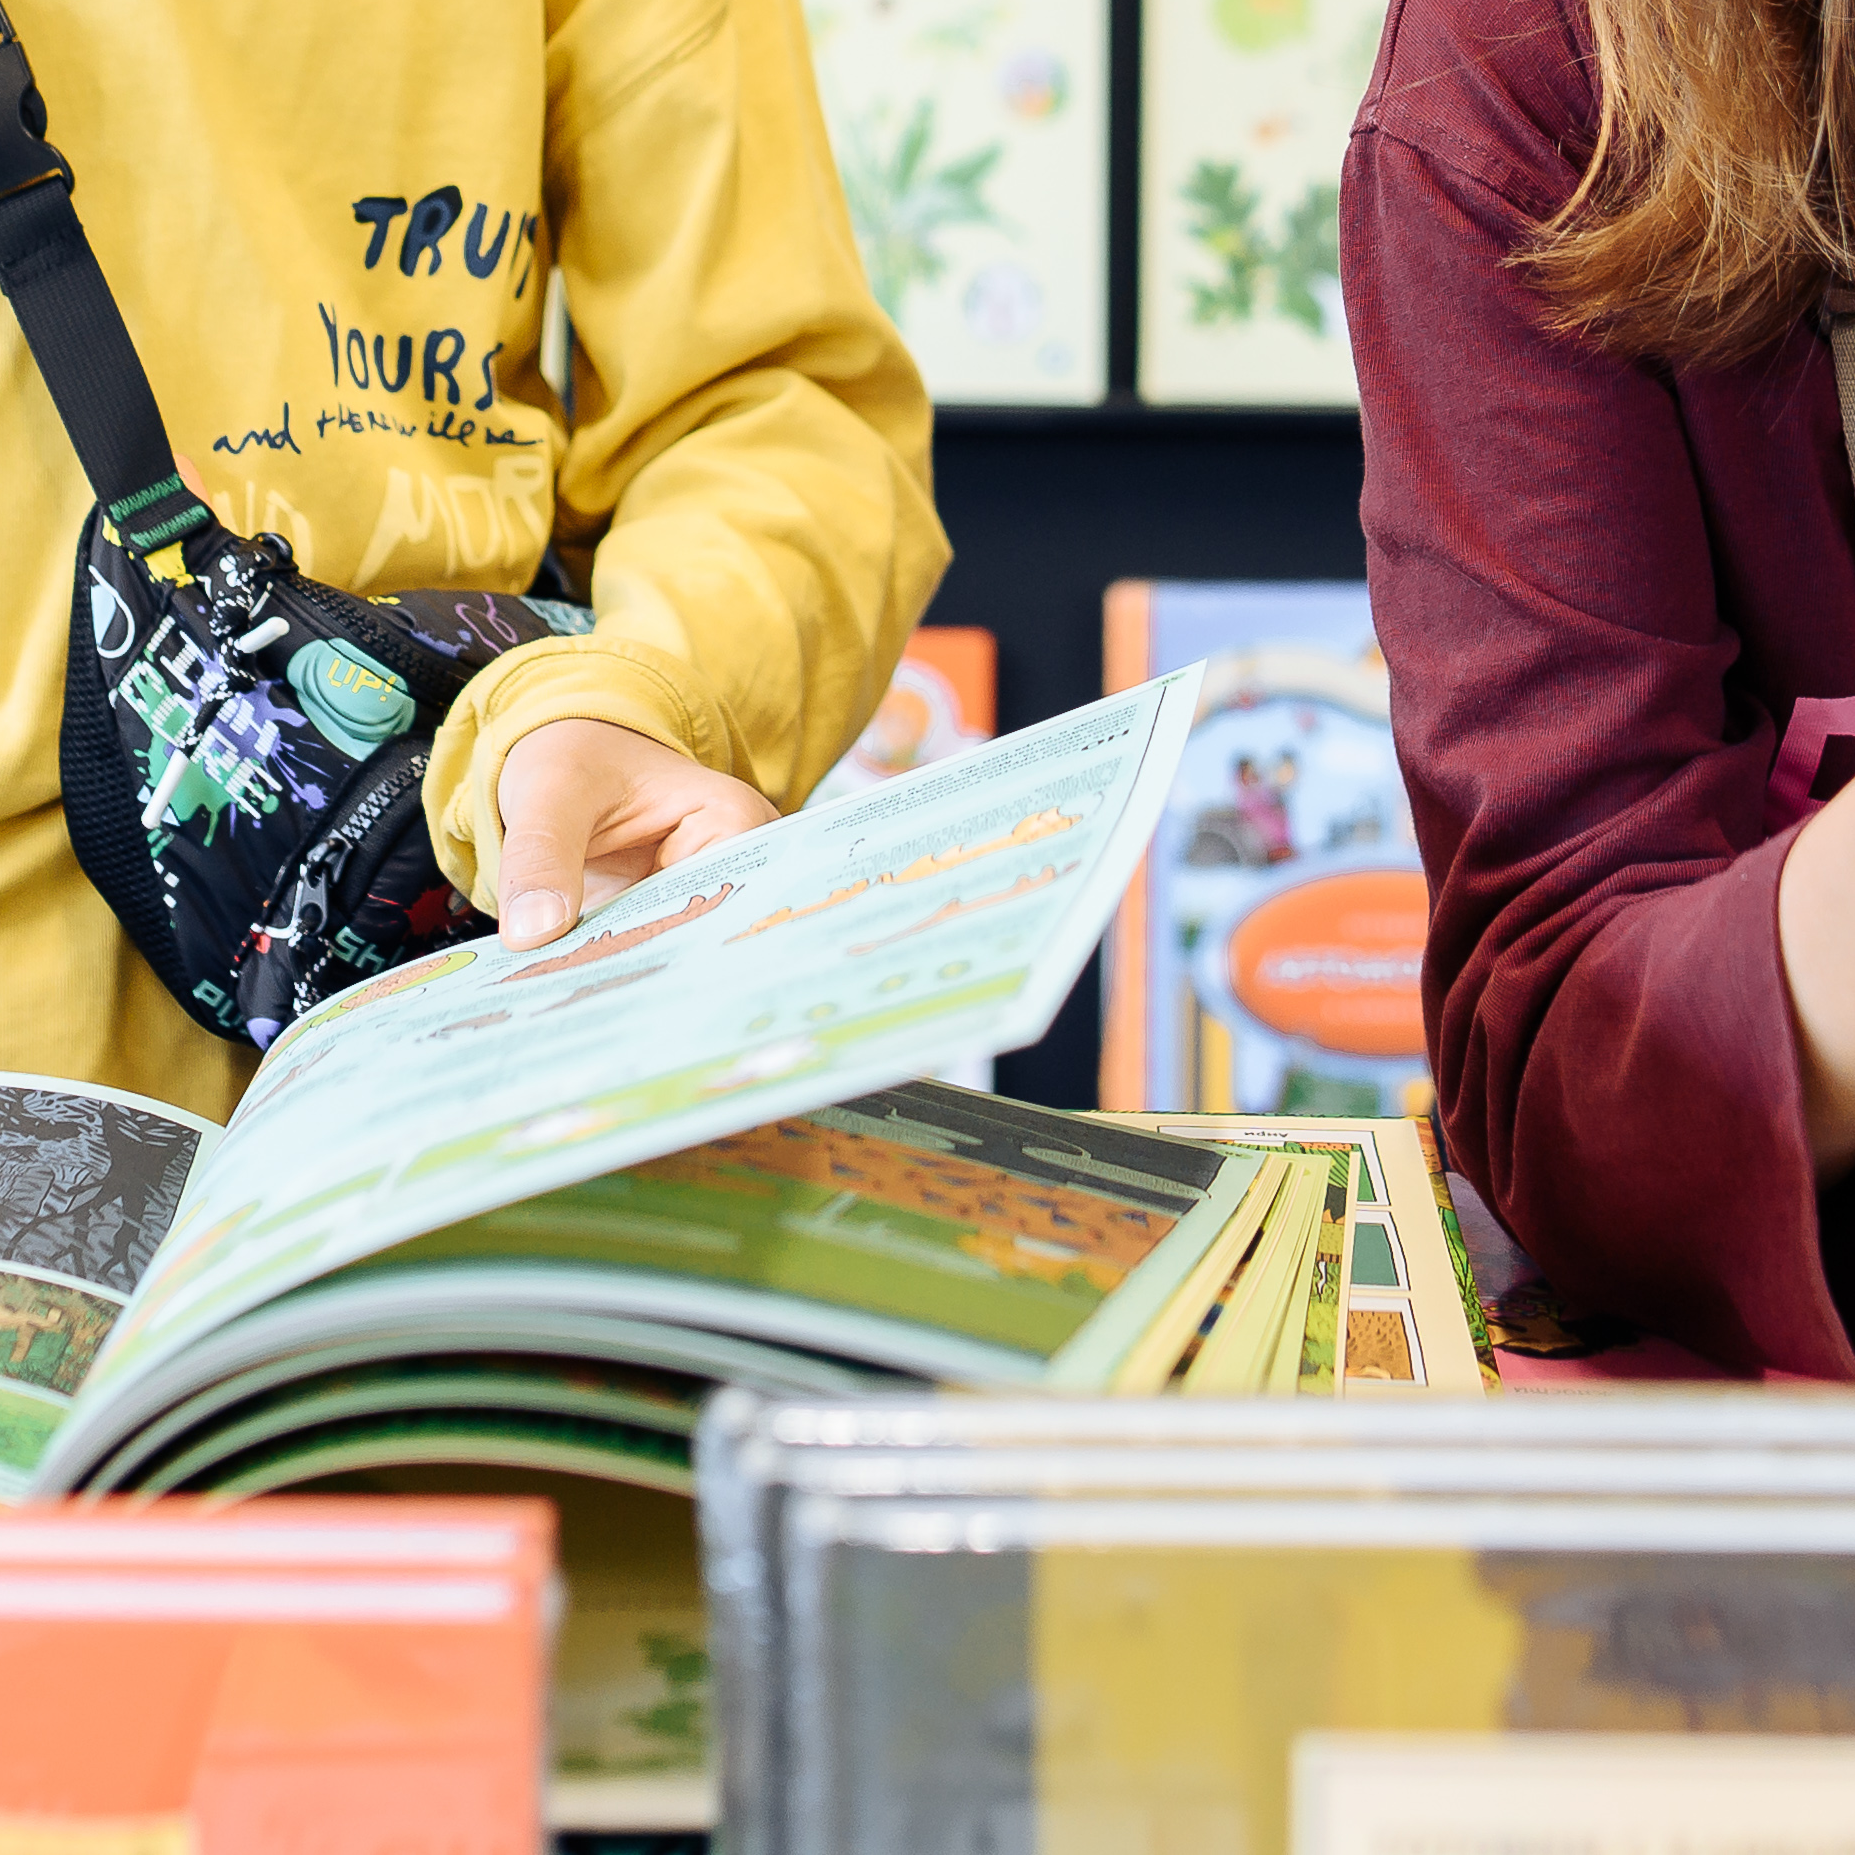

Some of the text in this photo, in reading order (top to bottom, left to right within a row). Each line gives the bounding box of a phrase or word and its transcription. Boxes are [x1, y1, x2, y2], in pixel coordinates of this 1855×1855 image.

[213, 402, 301, 454] and
[350, 454, 545, 591] MOR
[327, 657, 397, 702] UP!
